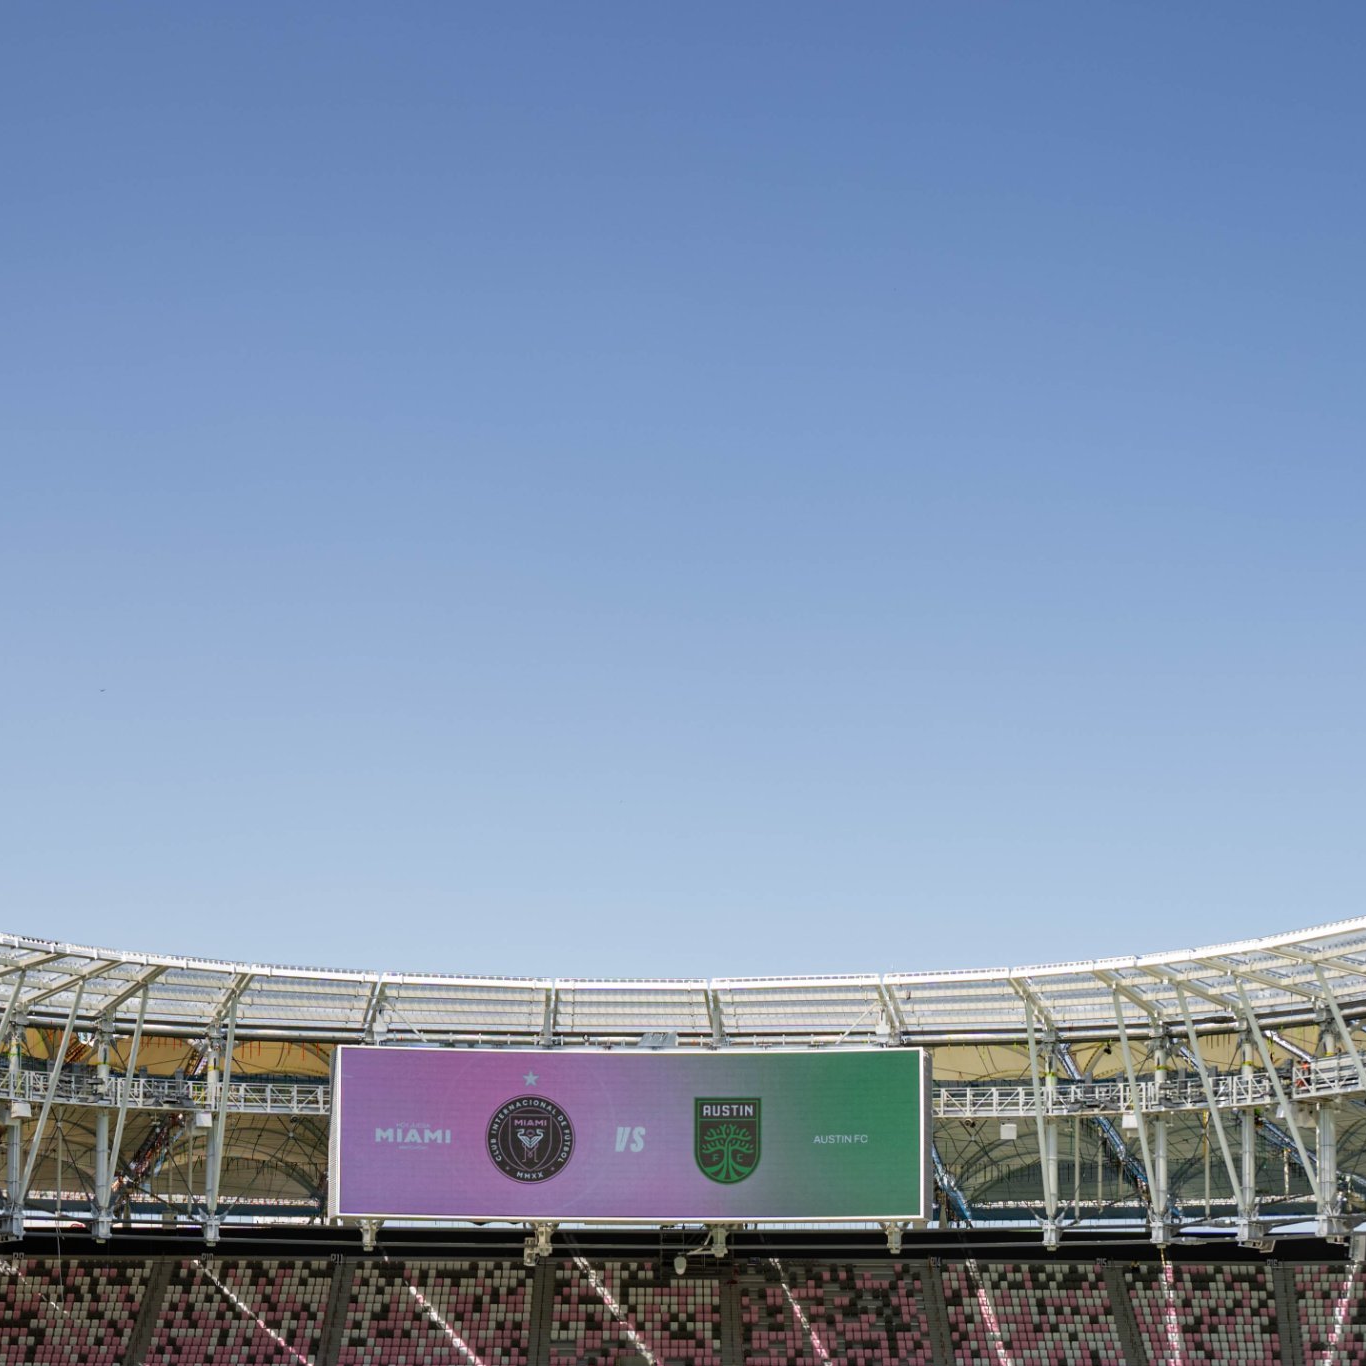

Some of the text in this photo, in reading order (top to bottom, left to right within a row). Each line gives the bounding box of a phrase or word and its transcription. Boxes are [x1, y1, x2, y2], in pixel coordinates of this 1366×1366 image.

[490, 1099, 557, 1134] INTERNACIONAL
[702, 1104, 754, 1117] AUSTIN
[514, 1119, 548, 1127] MIAMI
[557, 1114, 568, 1127] DE
[374, 1127, 452, 1144] MIAMI
[615, 1126, 646, 1153] VS
[813, 1134, 868, 1144] AUSTIN FC
[490, 1138, 502, 1162] CLUB
[516, 1171, 545, 1179] MMXX
